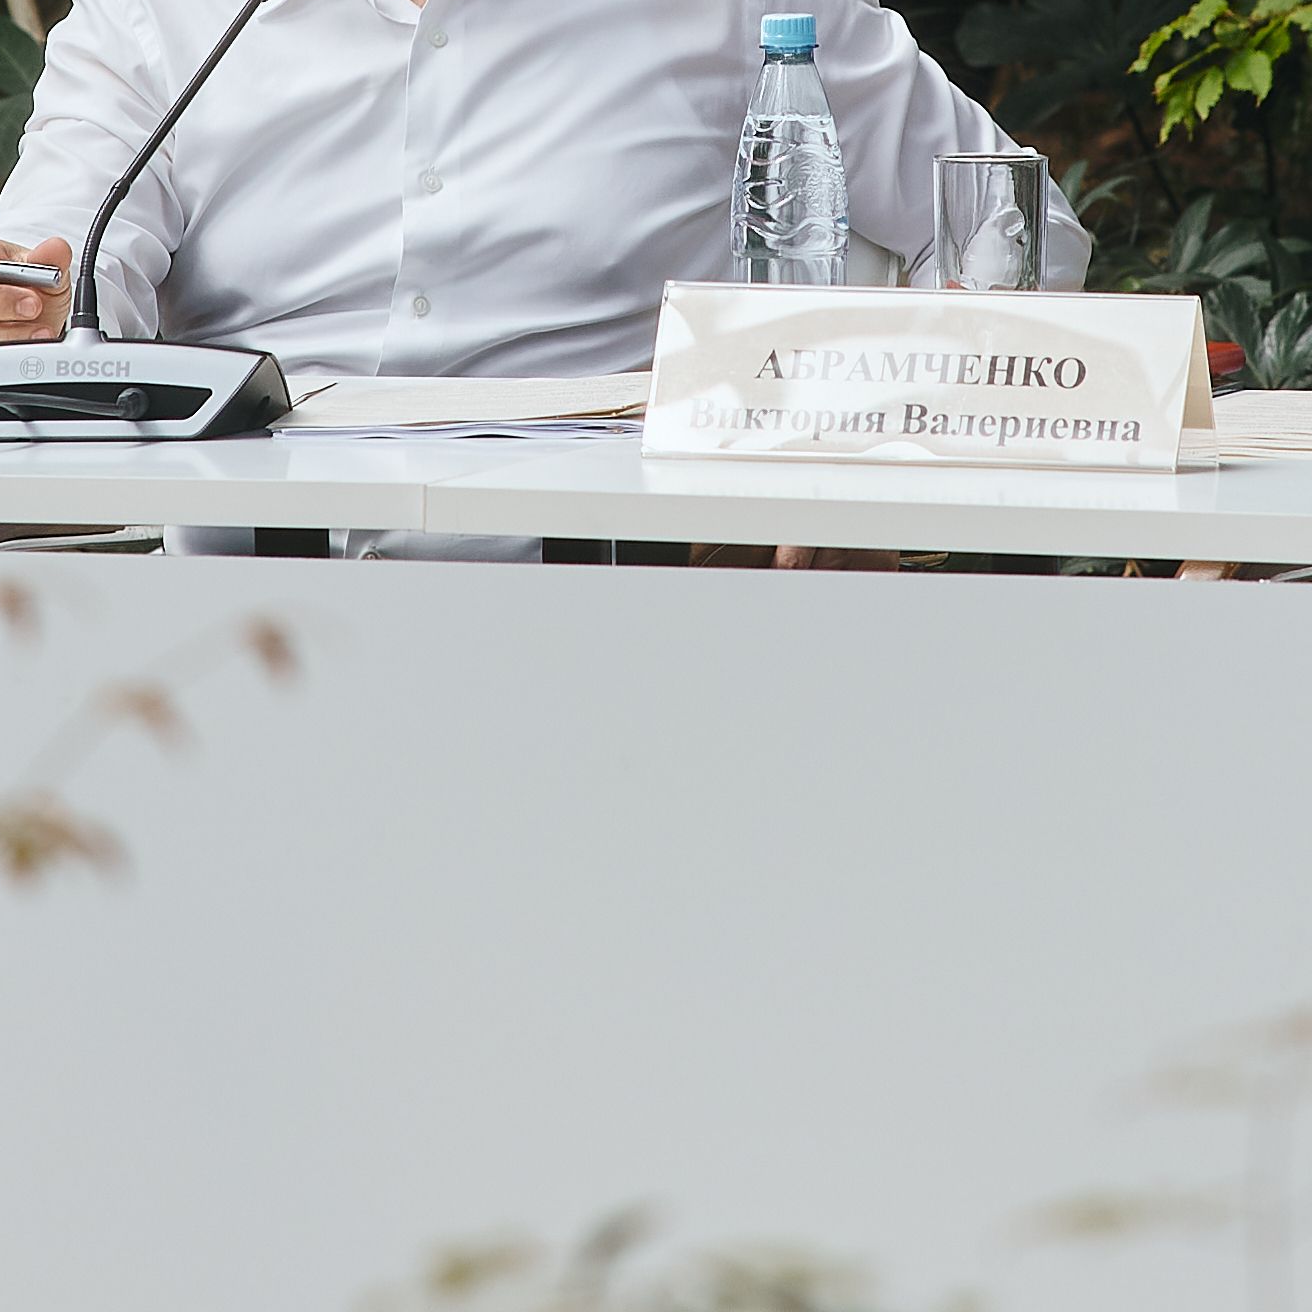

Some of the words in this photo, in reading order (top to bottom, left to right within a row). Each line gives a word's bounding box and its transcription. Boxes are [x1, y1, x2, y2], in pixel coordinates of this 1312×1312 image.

[55, 359, 131, 378] BOSCH
[754, 347, 1088, 390] АБРАМЧЕНКО
[688, 396, 886, 441] Виктория
[901, 402, 1142, 447] Валериевна
